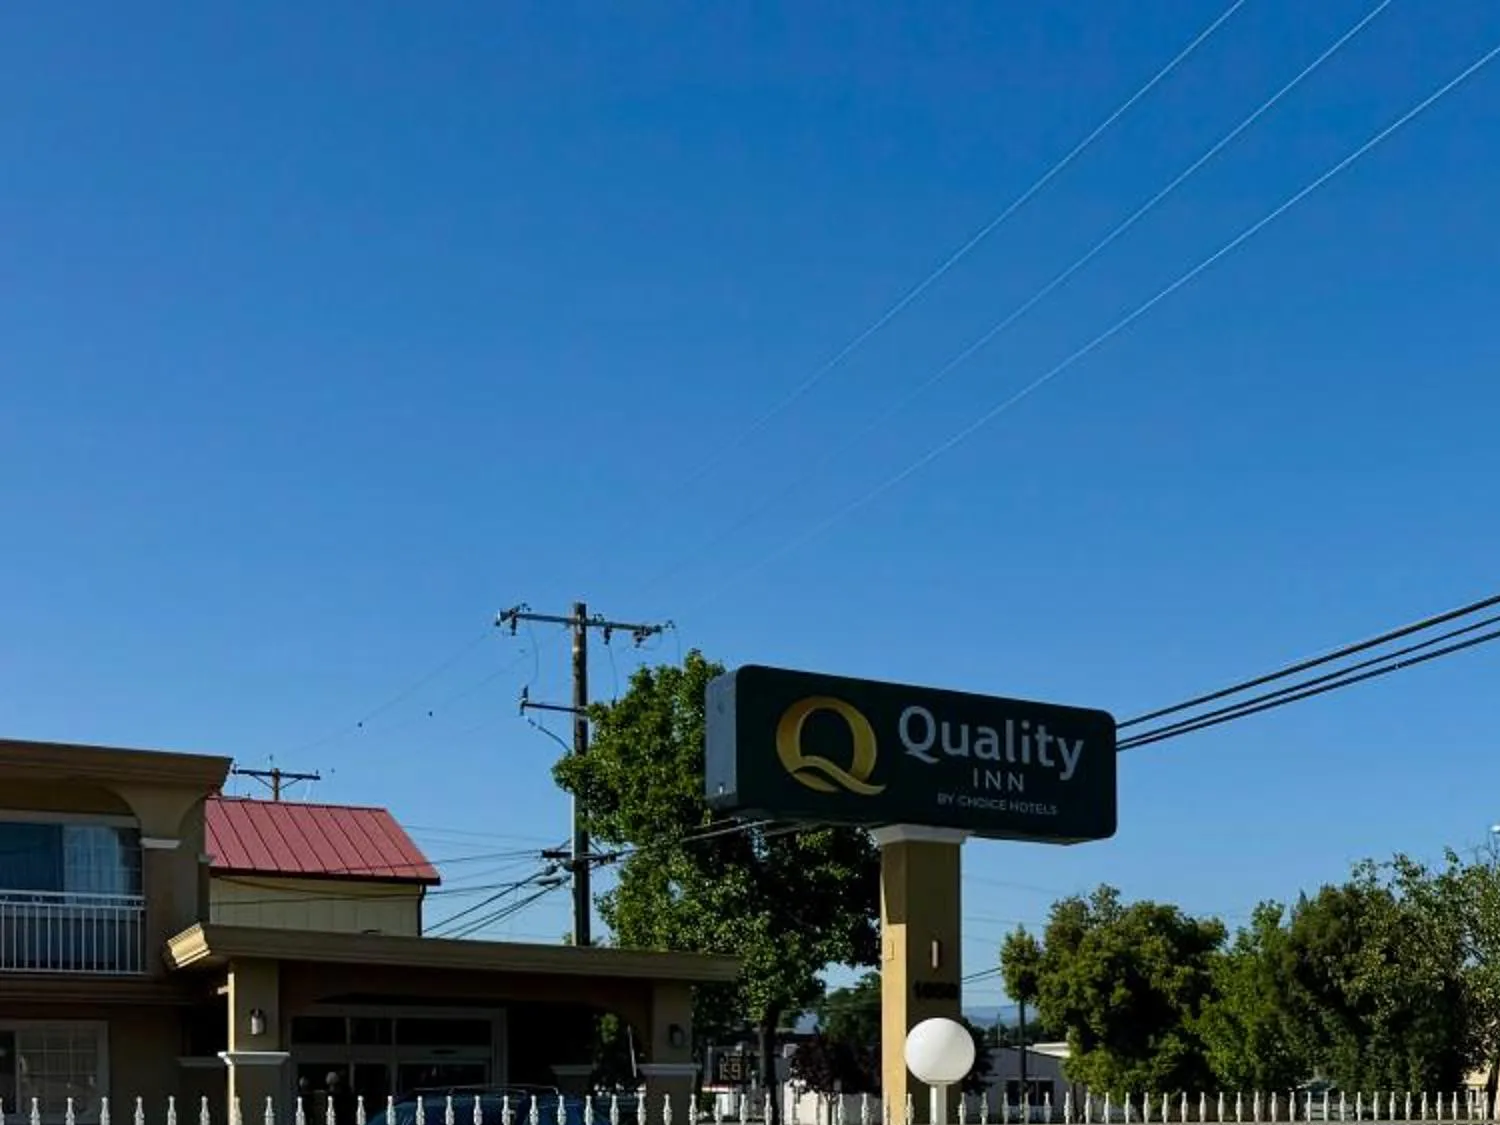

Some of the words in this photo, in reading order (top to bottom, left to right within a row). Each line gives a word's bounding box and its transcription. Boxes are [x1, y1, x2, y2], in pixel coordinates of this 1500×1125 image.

[899, 706, 1084, 781] Quality
[973, 767, 1024, 793] INN
[937, 792, 954, 806] BY
[957, 795, 1007, 811] CHOICE
[1009, 800, 1058, 816] HOTELS
